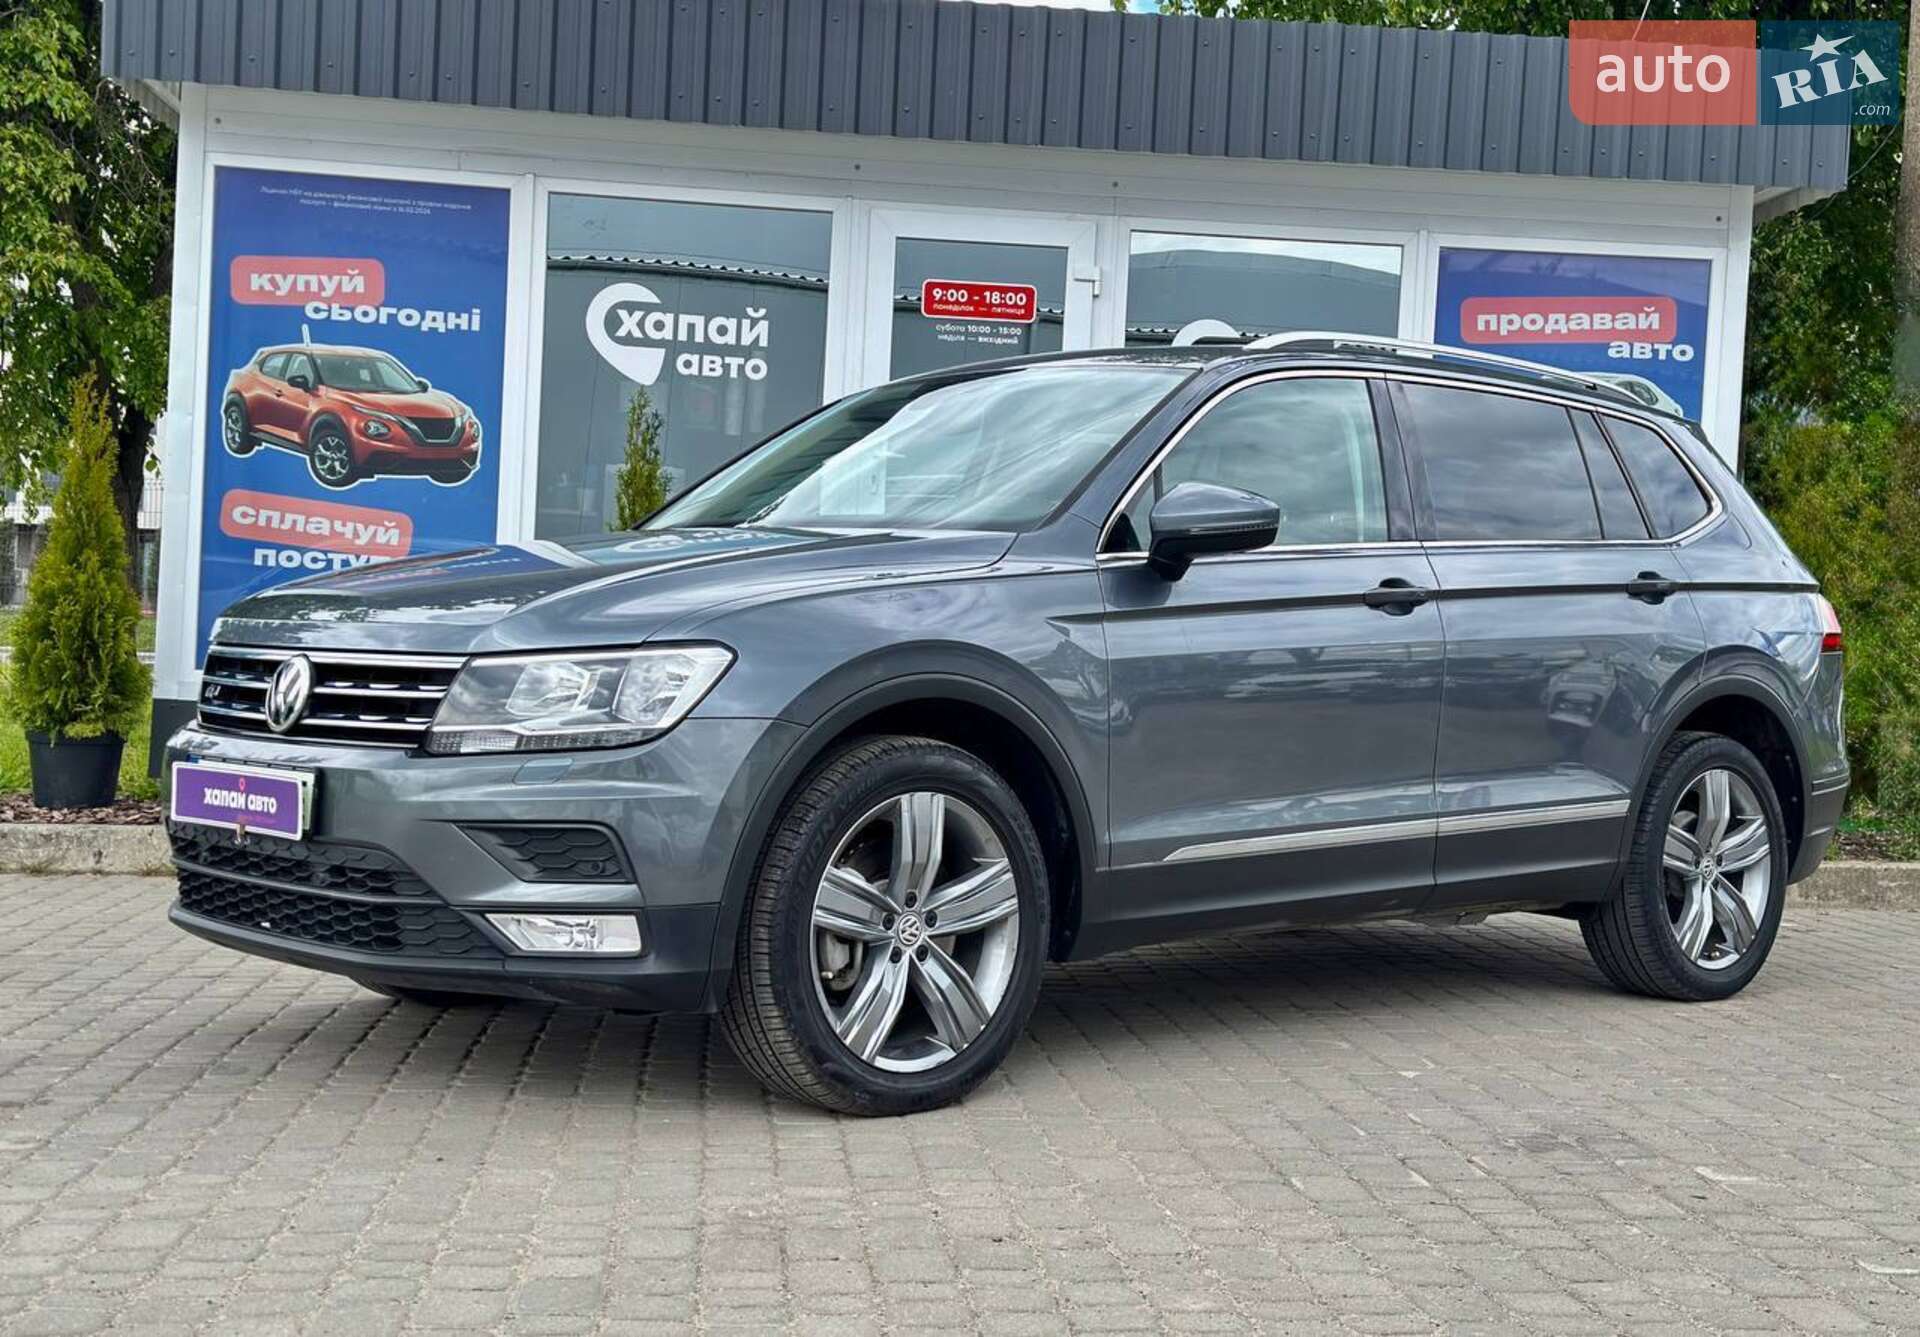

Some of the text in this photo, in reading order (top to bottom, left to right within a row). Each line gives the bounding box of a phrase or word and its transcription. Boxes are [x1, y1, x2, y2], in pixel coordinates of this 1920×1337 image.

[250, 269, 365, 297] купуй
[932, 288, 968, 302] 9:00
[983, 292, 1026, 306] 18:00
[304, 301, 480, 333] сьогодні
[614, 307, 769, 347] хапай
[1477, 306, 1660, 336] продавай
[1608, 341, 1694, 362] авто
[675, 353, 768, 380] авто
[232, 505, 400, 546] сплачуй
[247, 794, 277, 814] авто
